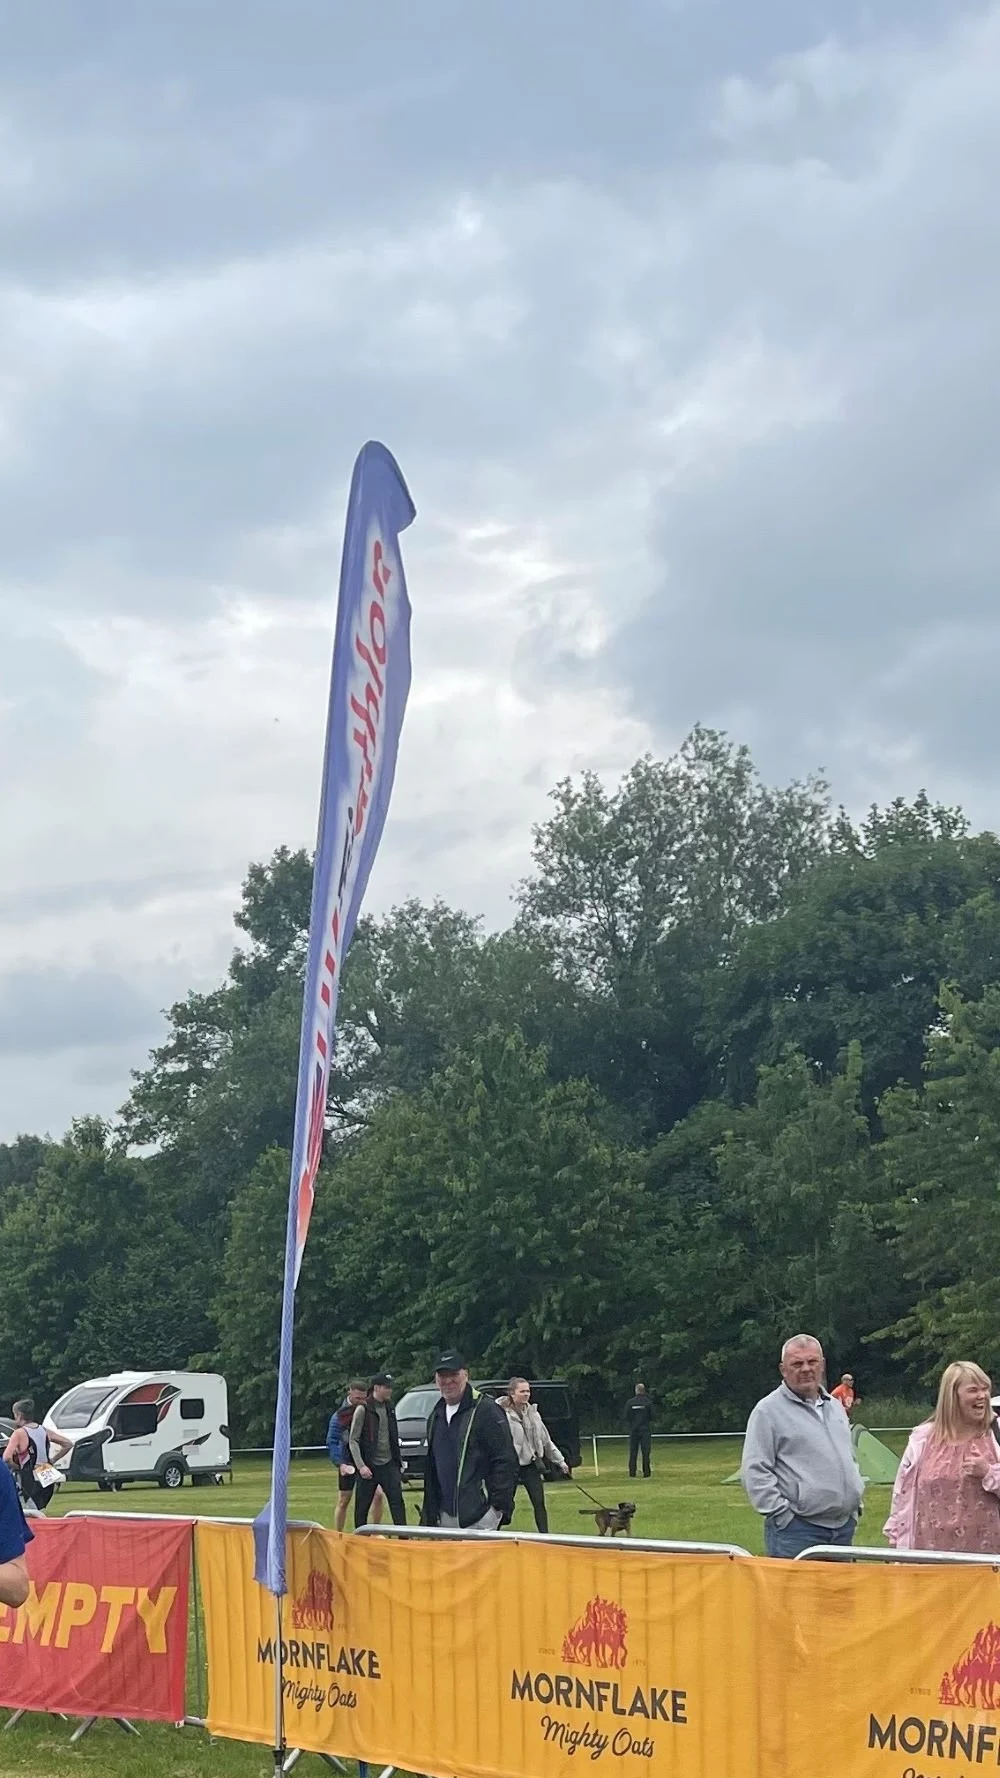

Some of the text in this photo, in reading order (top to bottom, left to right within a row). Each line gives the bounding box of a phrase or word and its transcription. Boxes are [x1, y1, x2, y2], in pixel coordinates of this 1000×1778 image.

[257, 1637, 381, 1679] MORNFLAKE
[281, 1675, 357, 1712] Mighty Oats
[511, 1669, 687, 1724] MORNFLAKE
[541, 1715, 655, 1760] Mighty Oats
[868, 1713, 1000, 1766] MORNF
